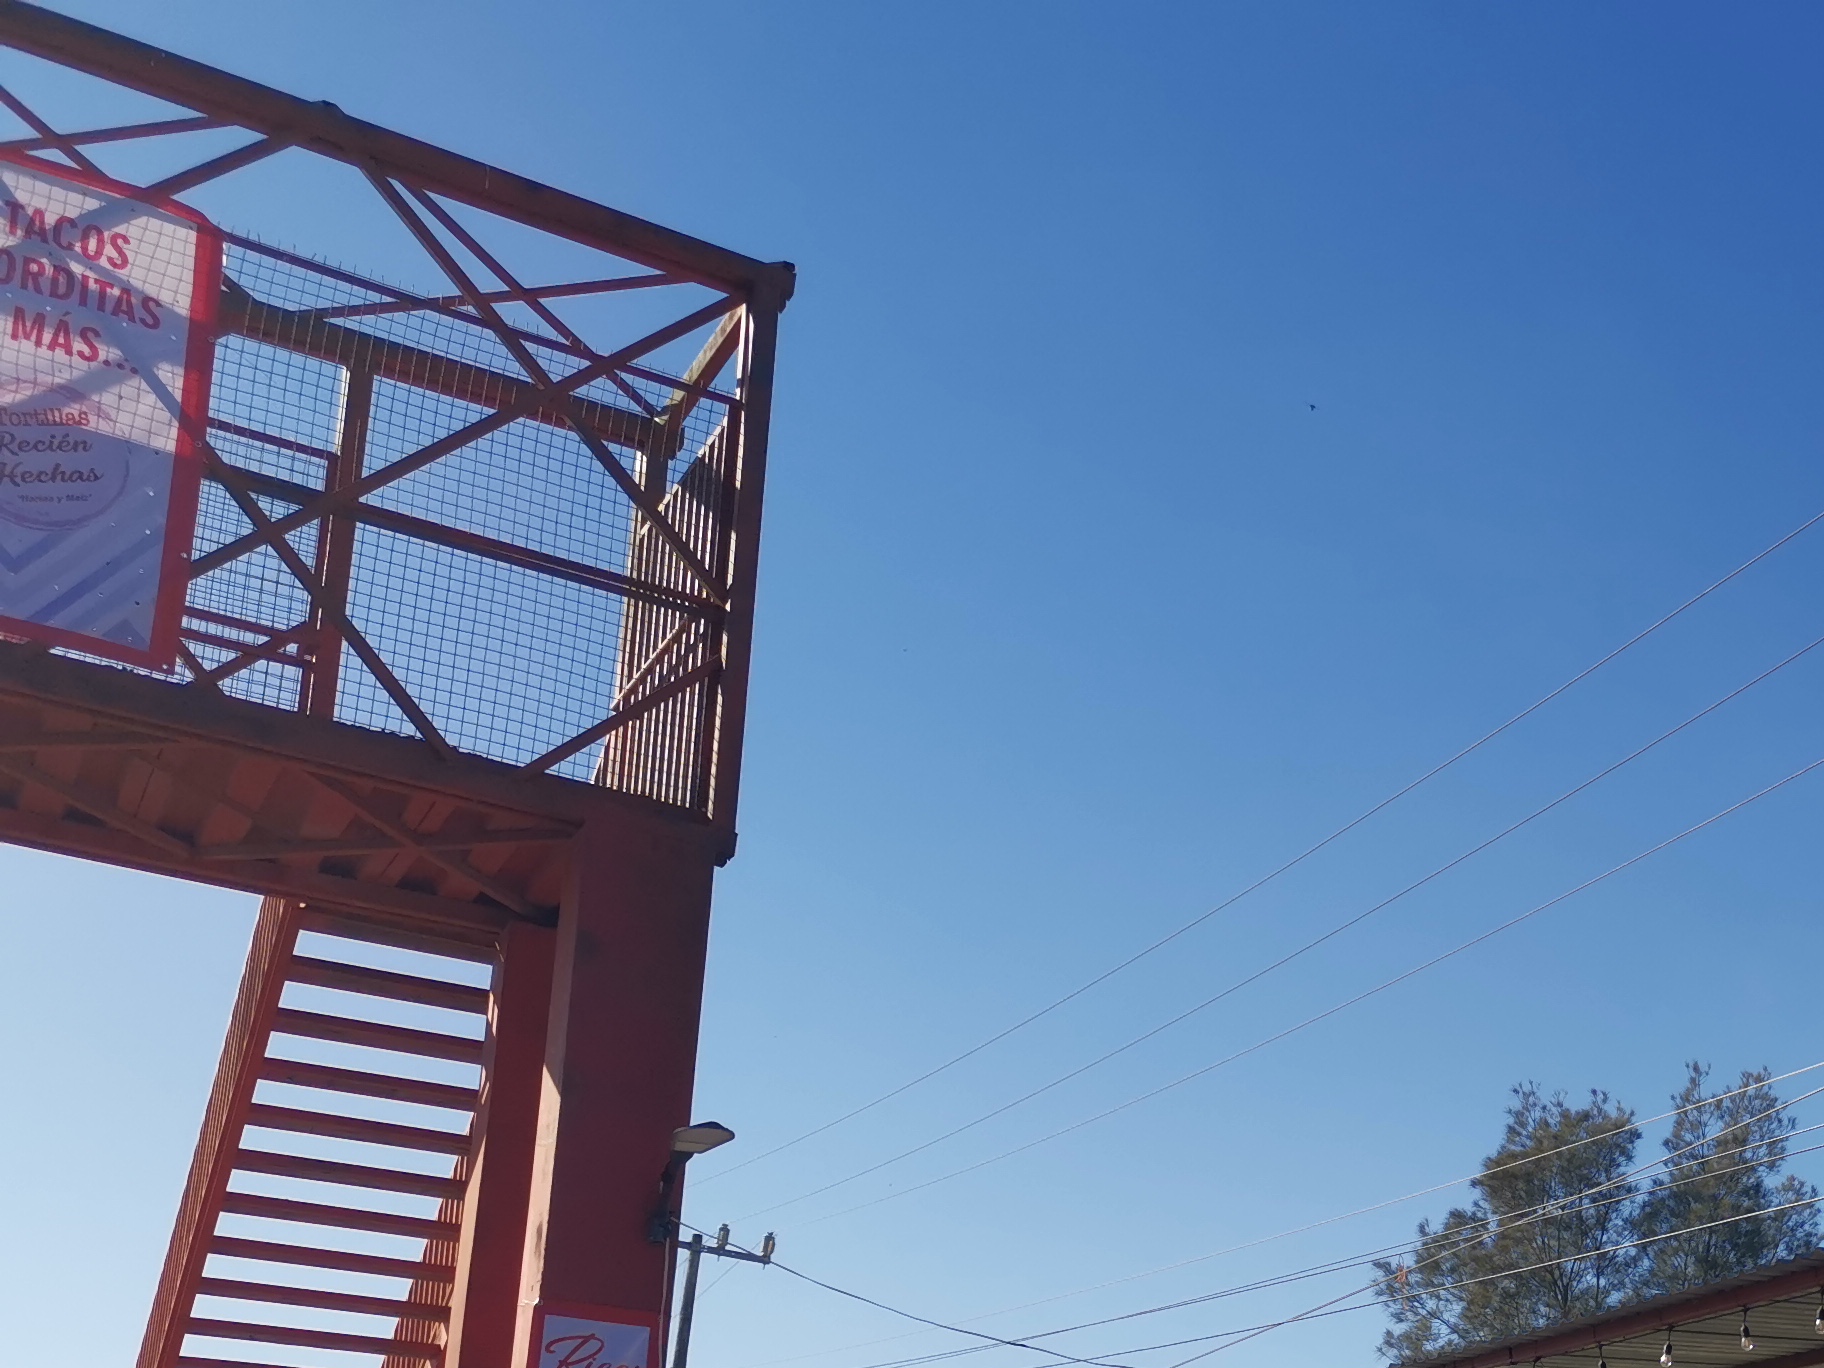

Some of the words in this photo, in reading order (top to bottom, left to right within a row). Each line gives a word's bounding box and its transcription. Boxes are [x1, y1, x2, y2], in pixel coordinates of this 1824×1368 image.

[5, 199, 131, 271] TACOS
[0, 247, 164, 331] ORDITAS
[10, 305, 139, 375] MÁS...
